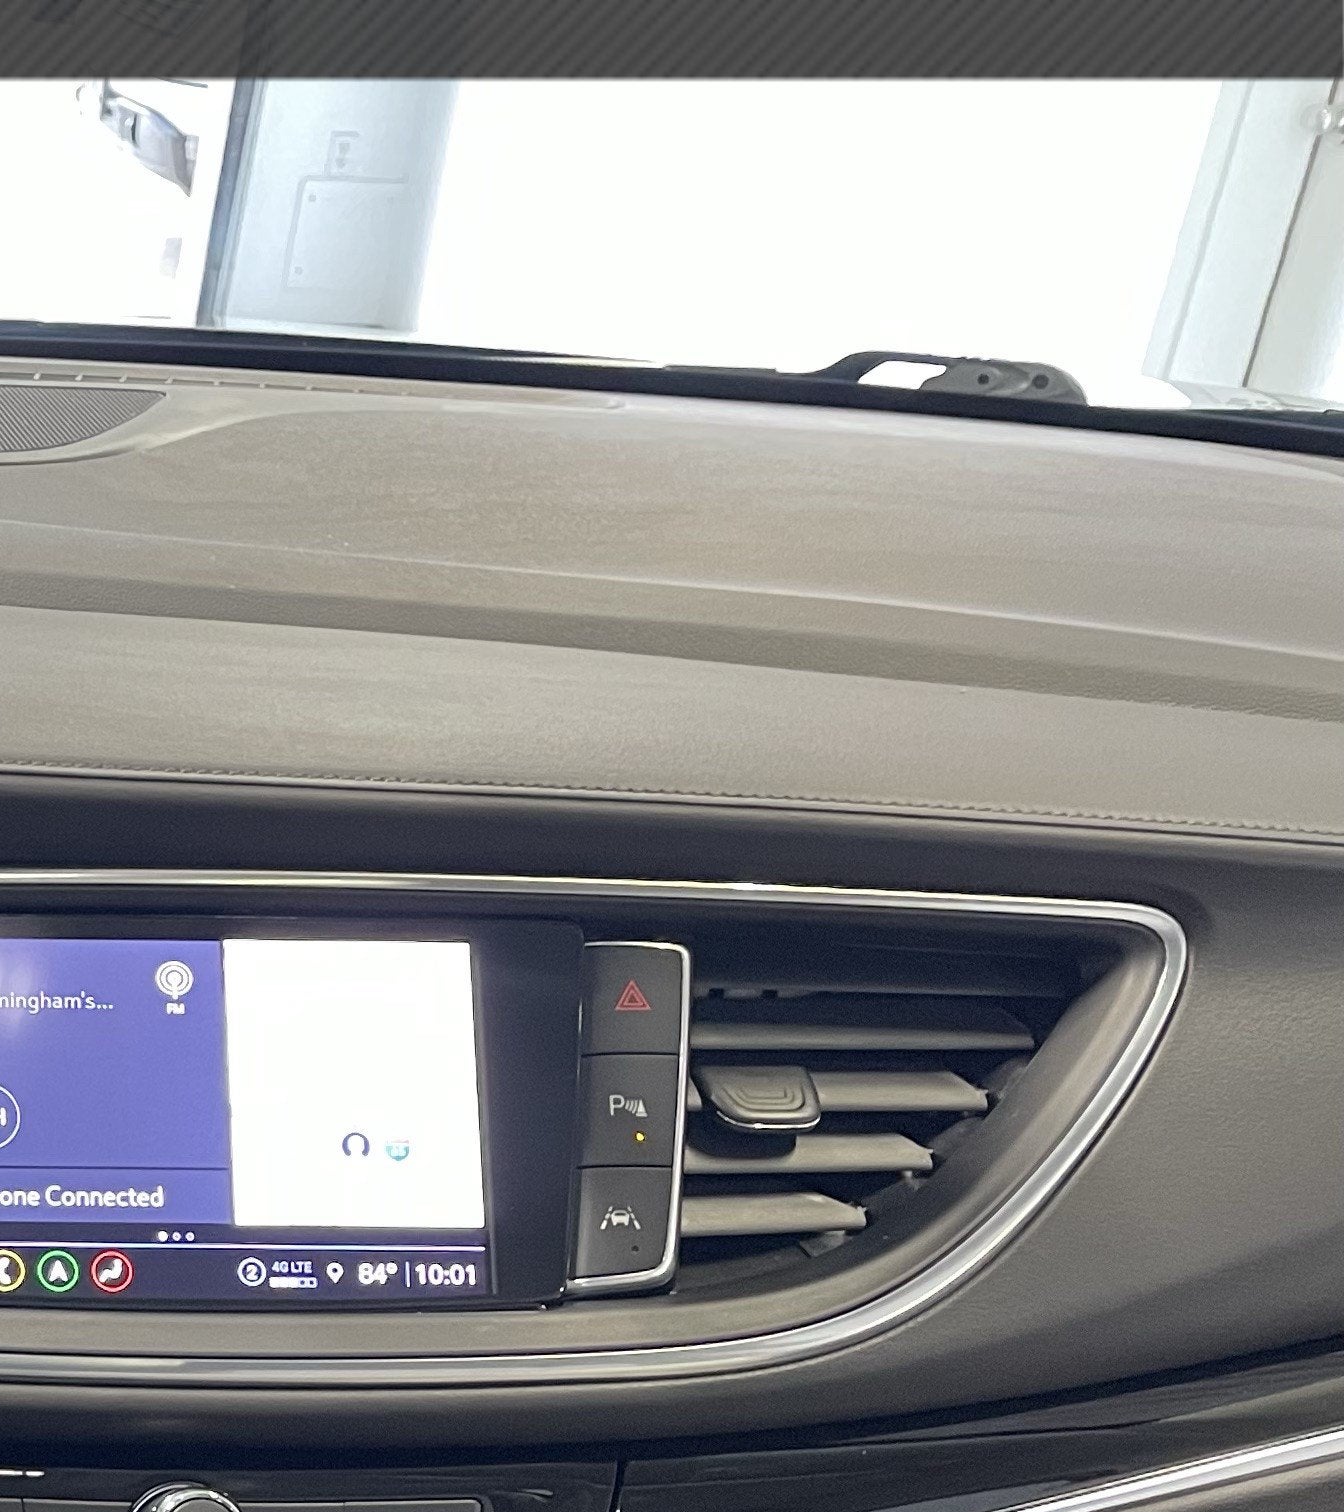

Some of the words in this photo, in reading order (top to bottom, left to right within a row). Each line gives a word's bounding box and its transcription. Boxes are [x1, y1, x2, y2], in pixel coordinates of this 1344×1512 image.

[44, 1185, 165, 1208] Connected
[290, 1262, 312, 1274] LTE
[415, 1263, 476, 1286] 10:01
